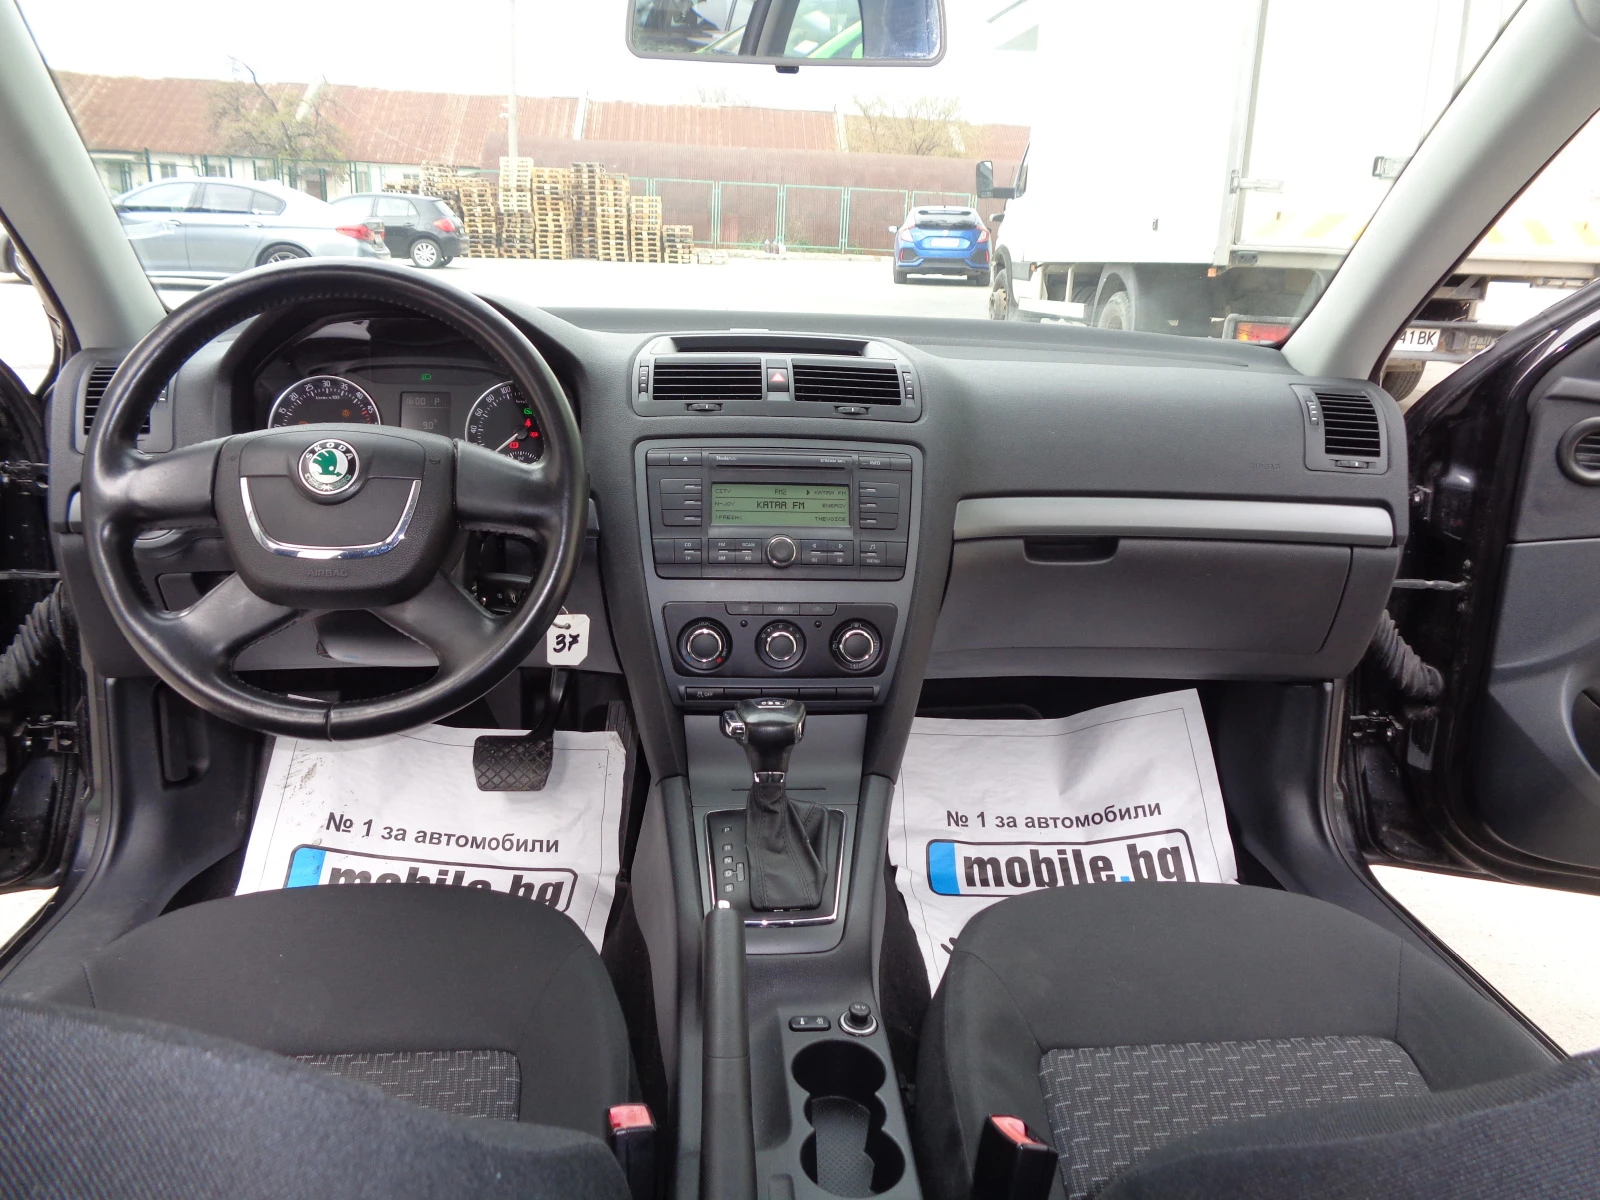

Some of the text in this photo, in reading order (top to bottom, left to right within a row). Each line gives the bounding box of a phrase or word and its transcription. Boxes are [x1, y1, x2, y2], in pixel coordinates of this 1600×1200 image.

[304, 383, 314, 392] 25
[340, 382, 348, 391] 35
[500, 385, 511, 394] 100
[288, 392, 299, 401] 20
[355, 391, 364, 400] 40
[485, 394, 495, 404] 80
[434, 398, 440, 406] P
[367, 405, 375, 414] 45
[474, 408, 484, 417] 60
[470, 425, 477, 433] 40
[792, 501, 805, 510] FM
[553, 634, 580, 653] 37
[947, 802, 1161, 829] № 1 за автомобили
[326, 811, 559, 854] № 1 за автомобили
[964, 842, 1185, 887] mobile.bg
